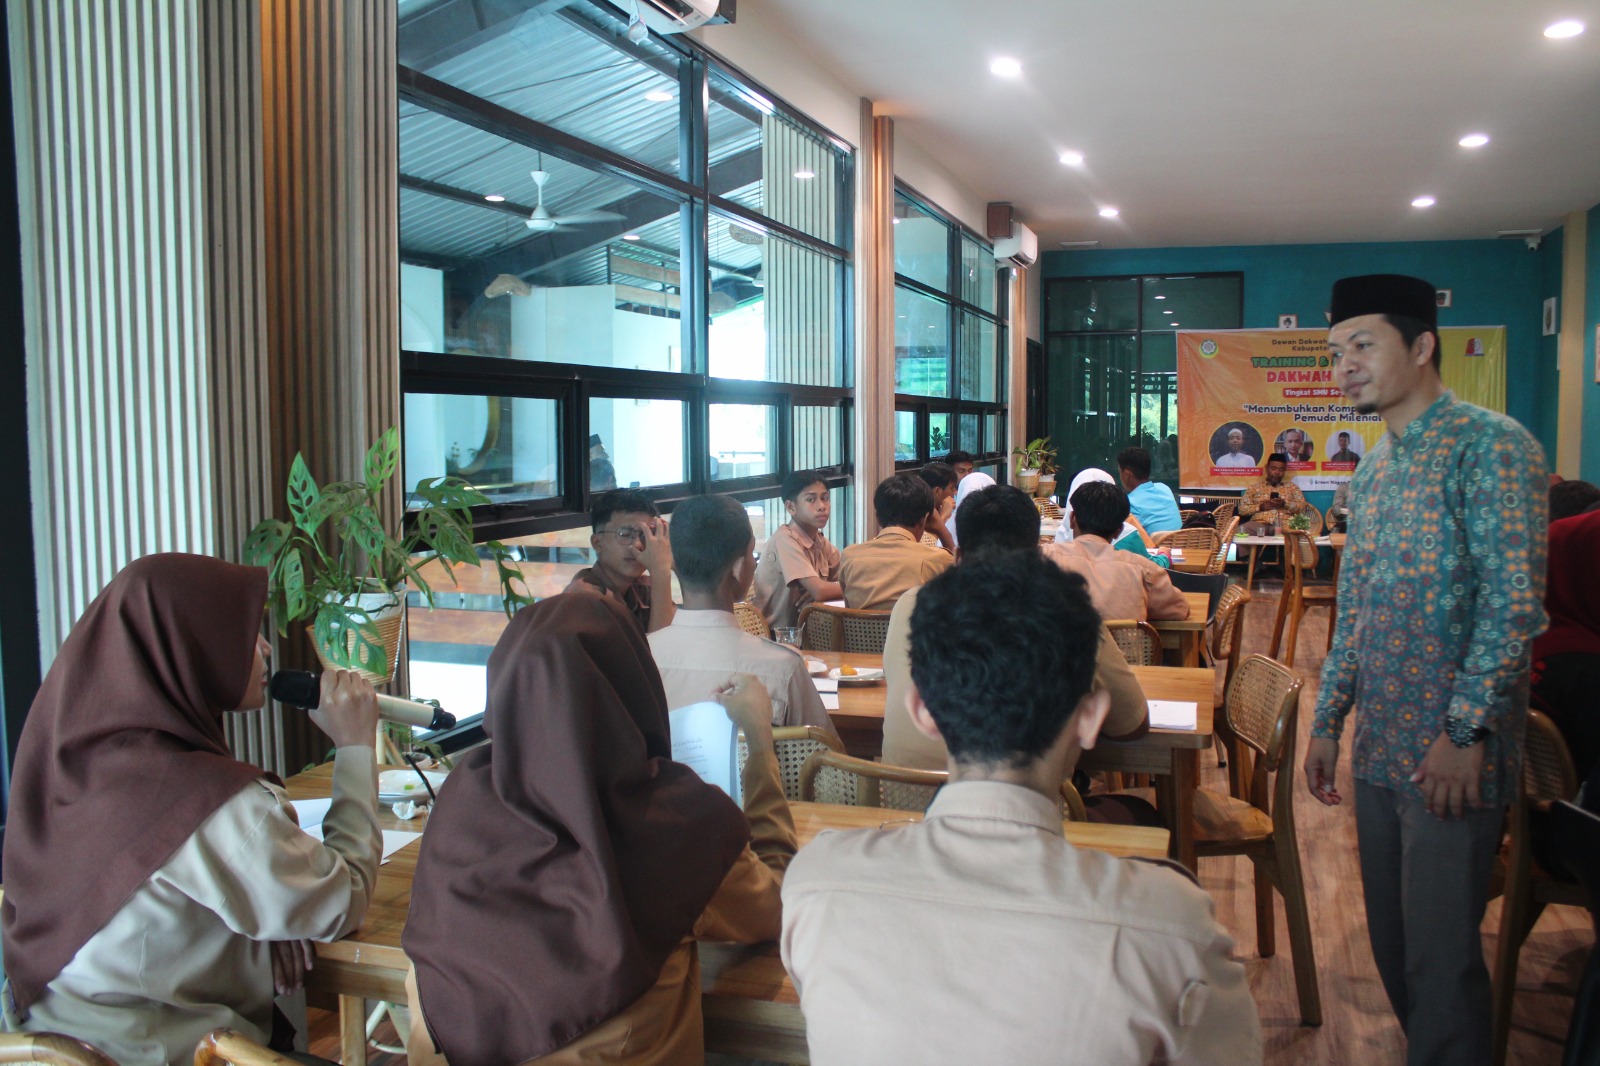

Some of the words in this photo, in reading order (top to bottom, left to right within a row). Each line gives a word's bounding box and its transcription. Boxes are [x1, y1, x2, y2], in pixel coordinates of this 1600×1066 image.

[1251, 356, 1316, 368] TRAINING
[1319, 356, 1328, 367] &
[1266, 370, 1332, 383] DAKWAH
[1285, 389, 1311, 397] Tingkat
[1244, 404, 1325, 413] "Menumbuhkan
[1294, 413, 1336, 422] Pemuda
[1339, 413, 1382, 422] Milenial
